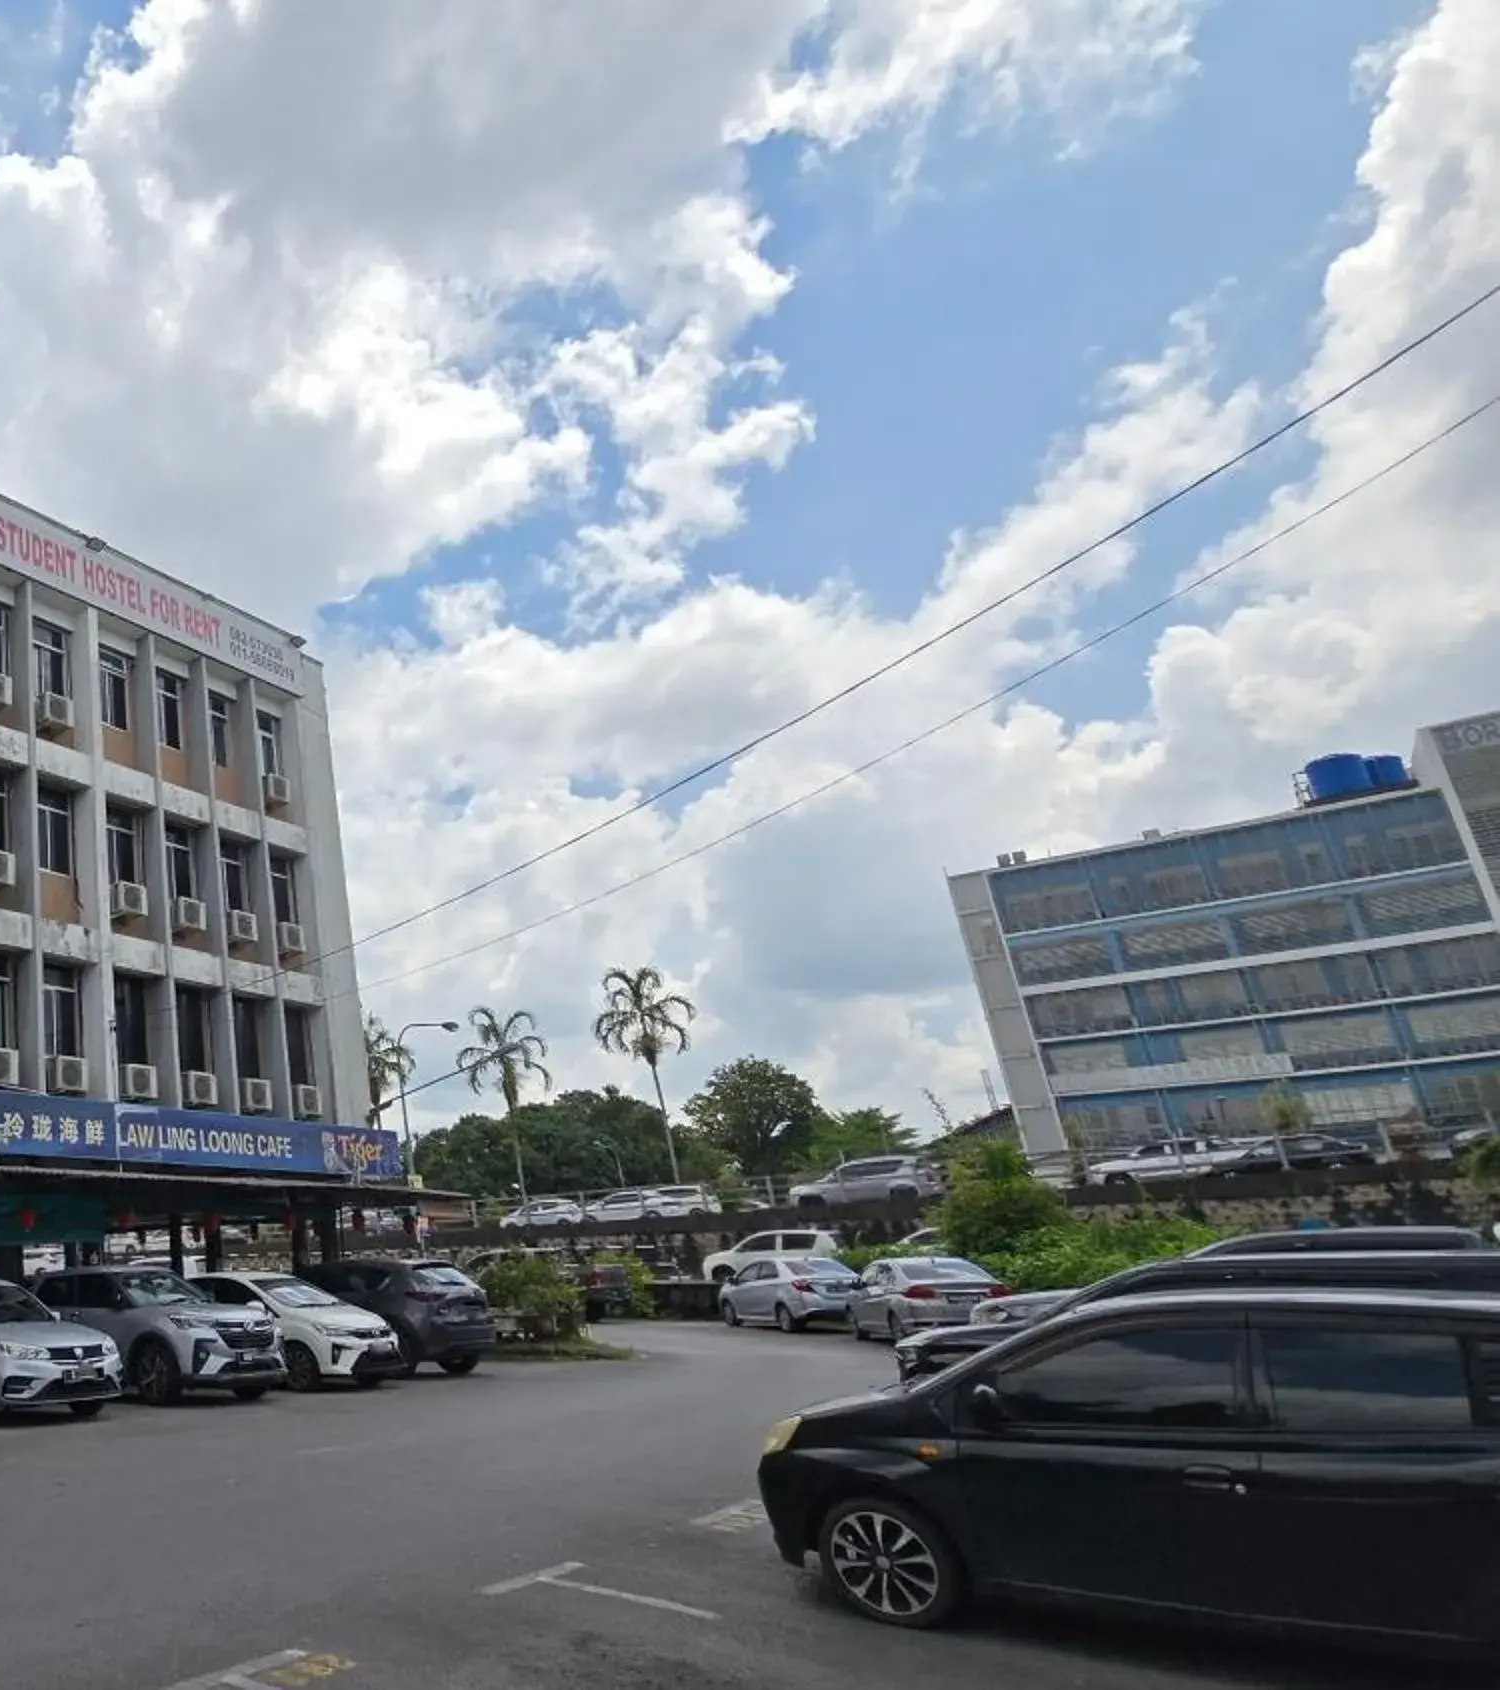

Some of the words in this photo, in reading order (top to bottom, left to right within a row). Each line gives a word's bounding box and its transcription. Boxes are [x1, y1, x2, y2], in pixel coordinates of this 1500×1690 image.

[82, 556, 148, 615] HOSTEL
[149, 588, 182, 631] FOR
[183, 602, 222, 649] RENT
[118, 1121, 156, 1149] LAW
[157, 1125, 197, 1152] LING
[199, 1129, 255, 1155] LOONG
[256, 1134, 293, 1160] CAFE
[337, 1132, 384, 1172] Tiger
